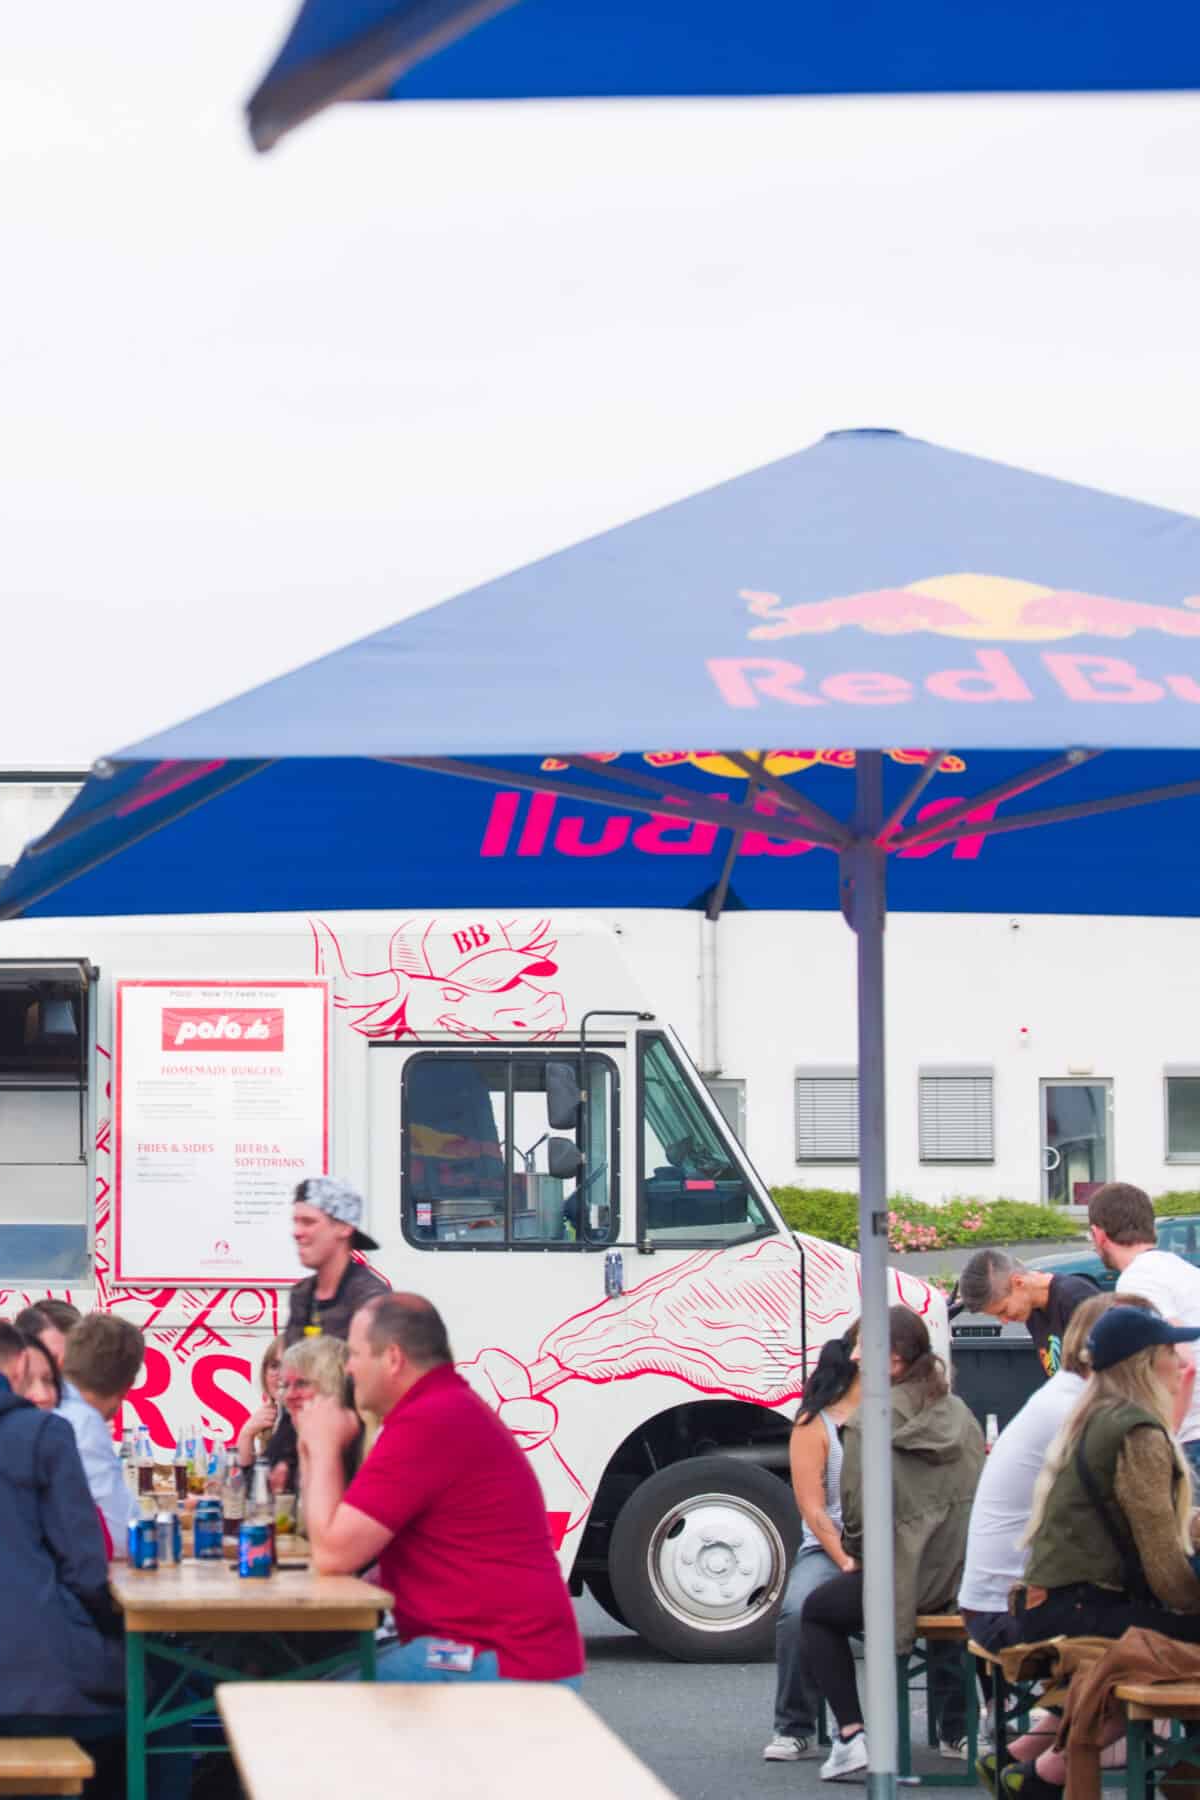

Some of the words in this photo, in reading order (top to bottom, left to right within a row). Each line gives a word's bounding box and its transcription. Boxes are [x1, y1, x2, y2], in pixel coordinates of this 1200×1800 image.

[704, 648, 1035, 709] Red
[452, 923, 491, 955] BB
[174, 1015, 242, 1046] polo
[137, 1143, 169, 1153] FRIES
[183, 1143, 215, 1153] SIDES
[234, 1157, 305, 1168] SOFTDRINKS
